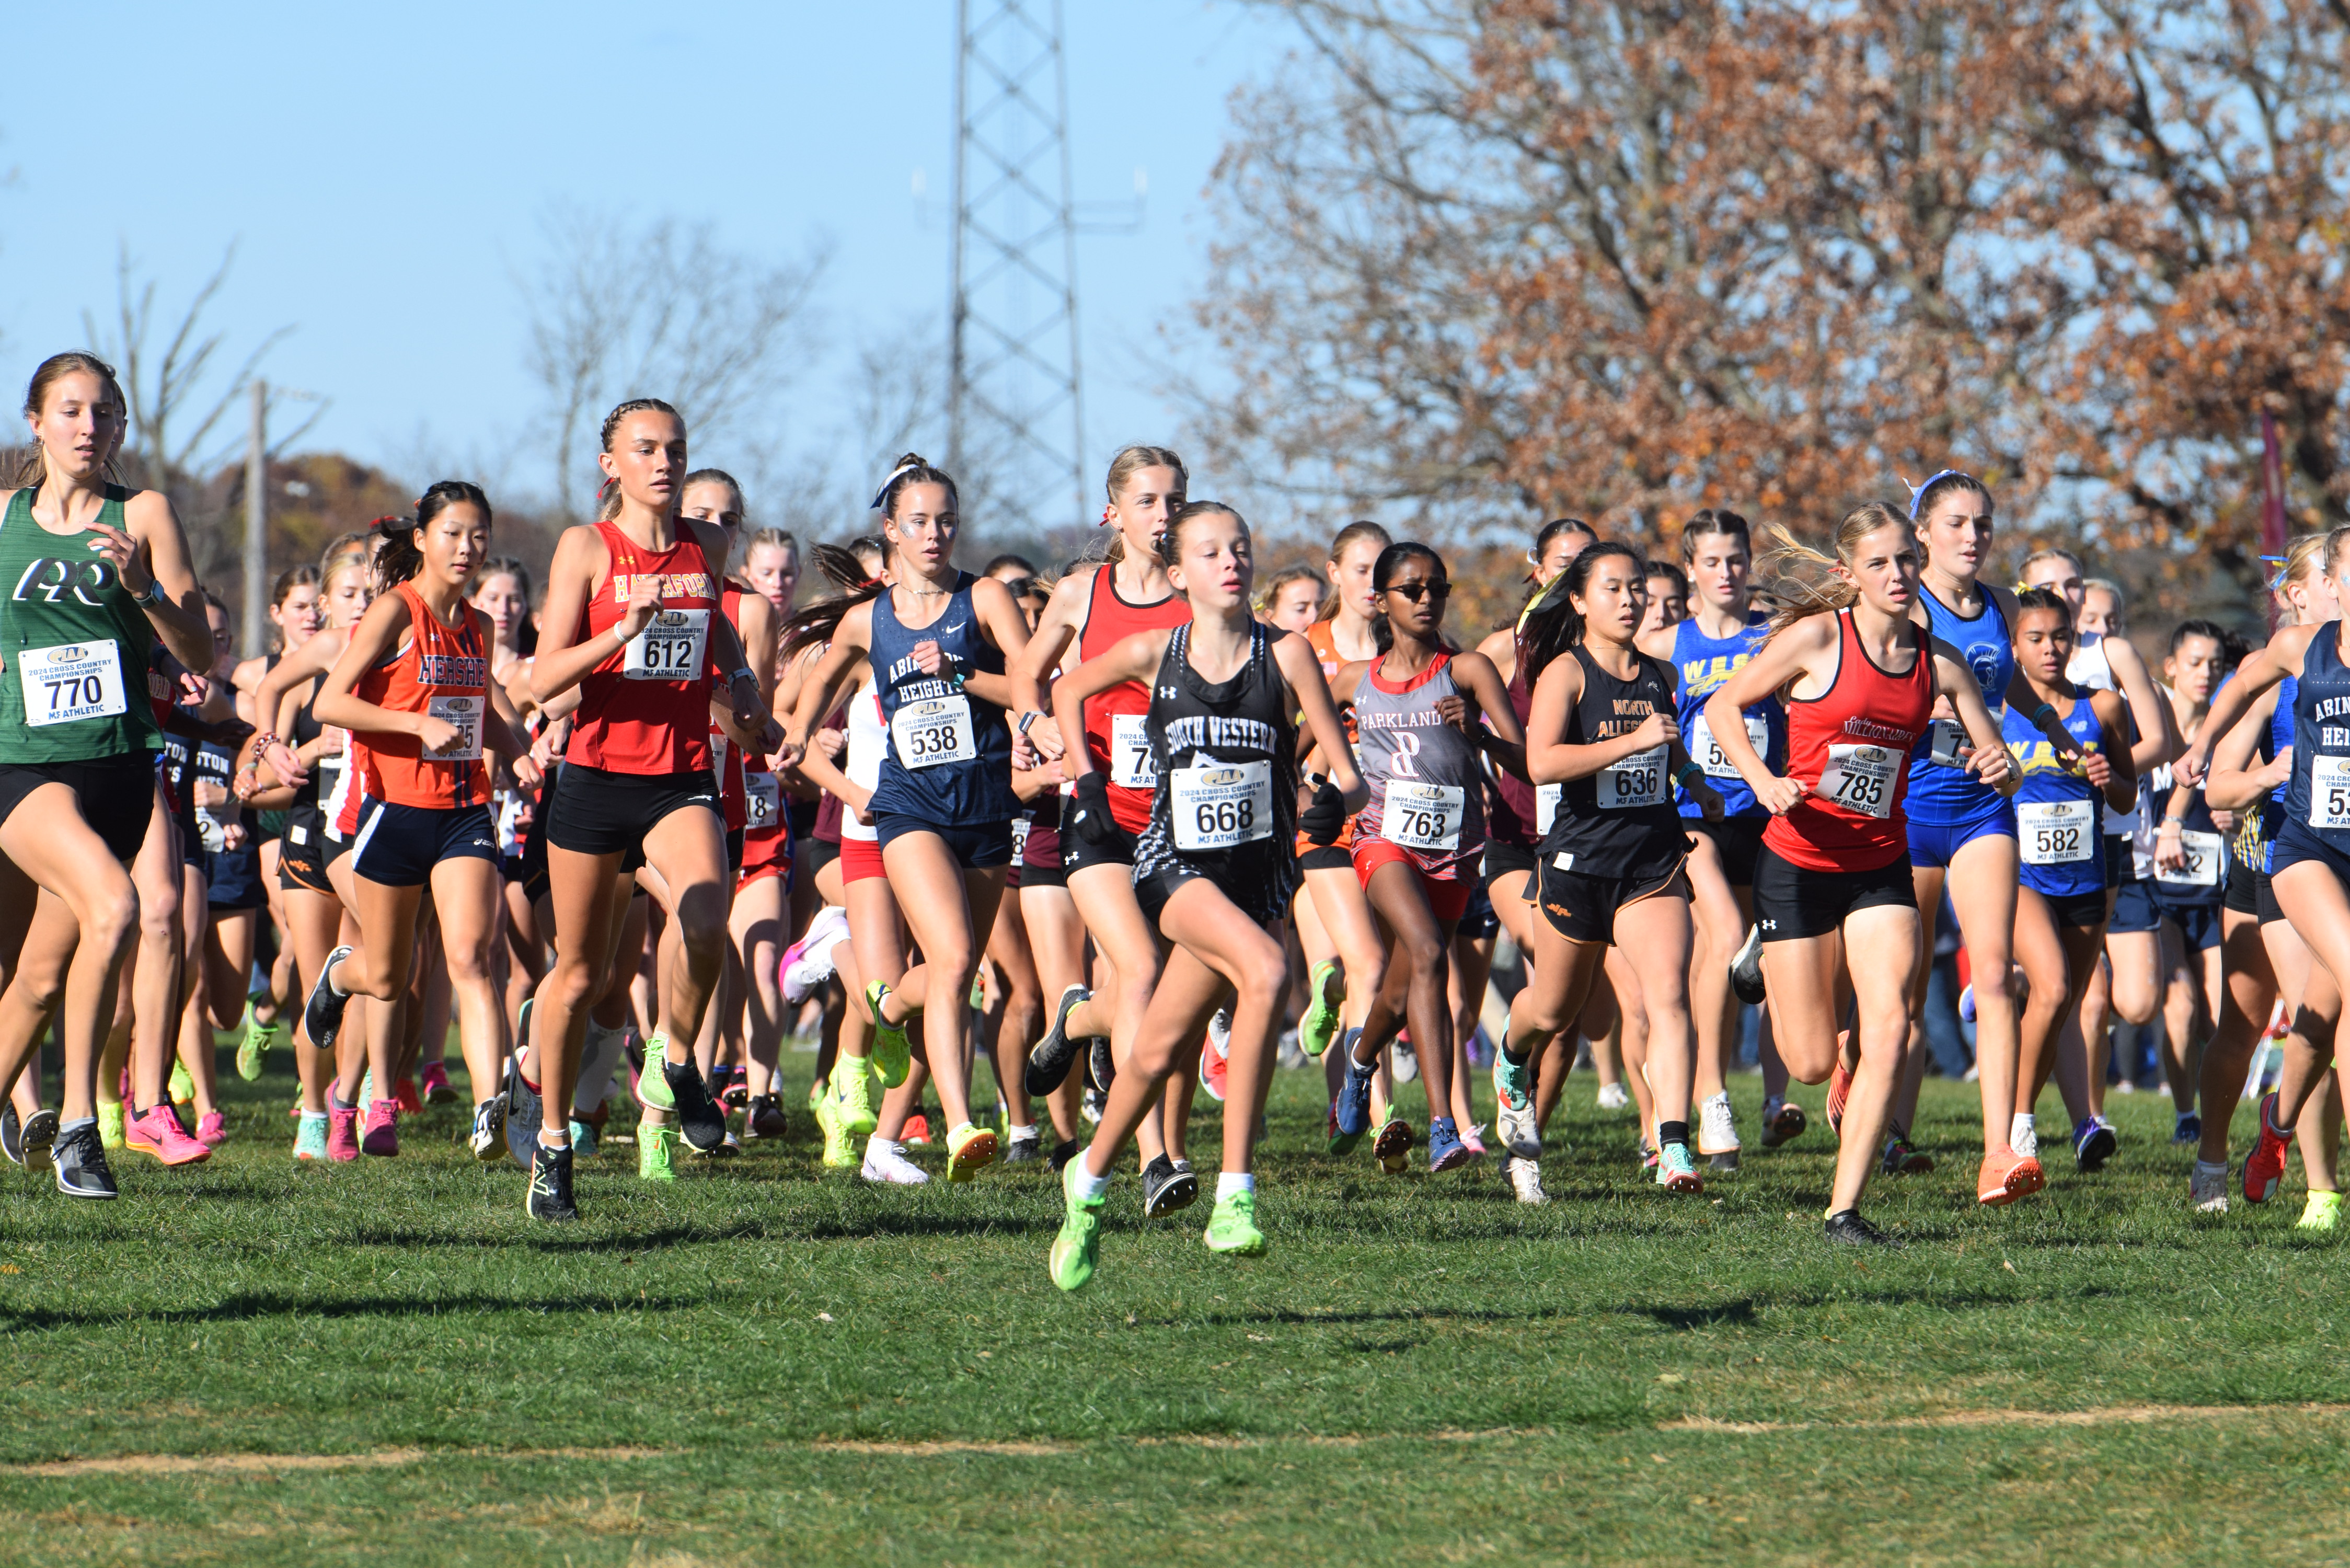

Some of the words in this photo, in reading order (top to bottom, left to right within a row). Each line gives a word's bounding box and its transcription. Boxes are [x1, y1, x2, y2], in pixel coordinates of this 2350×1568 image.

[662, 613, 686, 625] PIAA
[53, 648, 87, 662] PIAA
[644, 640, 692, 668] 612
[49, 665, 75, 673] CROSS
[76, 659, 111, 670] COUNTRY
[417, 654, 487, 688] HERSHE
[40, 667, 102, 681] CHAMPIONSHIPS
[44, 675, 102, 709] 770
[63, 705, 105, 718] ATHLETIC
[916, 702, 944, 714] PIAA
[1612, 699, 1655, 715] NORTH
[936, 712, 964, 720] COUNTRY
[1361, 711, 1441, 730] PARKLAND
[1849, 716, 1872, 727] Lady
[905, 719, 957, 731] CHAMPIONSHIPS
[1841, 721, 1916, 742] MILLIONAIRES
[911, 726, 958, 755] 538
[1165, 716, 1205, 755] SOUTH
[1208, 716, 1277, 755] WESTERN
[925, 751, 959, 762] ATHLETIC
[1840, 764, 1889, 778] CHAMPIONSHIPS
[1851, 760, 1872, 769] CROSS
[1207, 769, 1241, 783] PIAA
[1616, 768, 1657, 796] 636
[1202, 787, 1229, 795] CROSS
[1231, 780, 1265, 792] COUNTRY
[1413, 787, 1443, 798] PIAA
[1836, 771, 1884, 804] 785
[1191, 790, 1256, 802] CHAMPIONSHIPS
[1629, 795, 1655, 804] ATHLETIC
[1400, 802, 1450, 813] CHAMPIONSHIPS
[1842, 800, 1877, 814] ATHLETIC
[1196, 799, 1254, 833] 668
[1402, 809, 1446, 837] 763
[1214, 828, 1253, 843] ATHLETIC
[1410, 836, 1442, 846] ATHLETIC
[2037, 828, 2079, 852] 582
